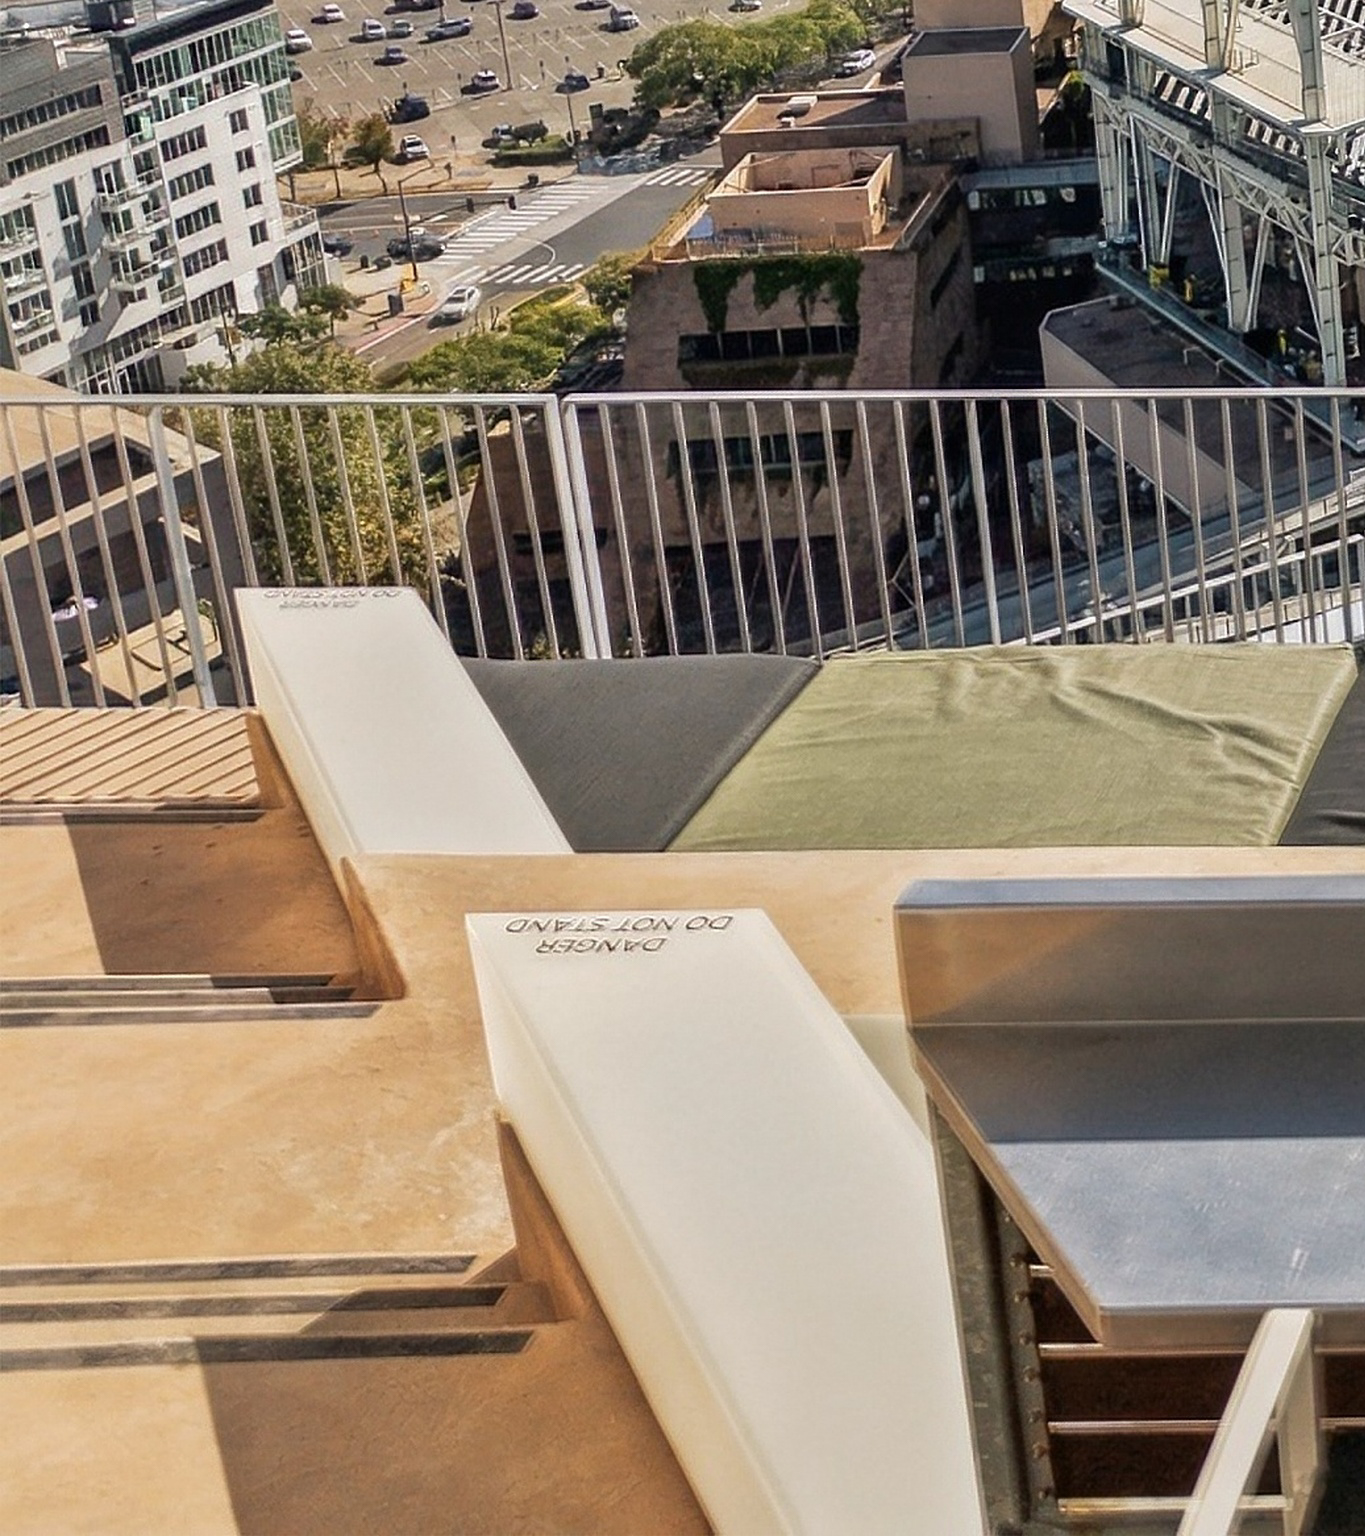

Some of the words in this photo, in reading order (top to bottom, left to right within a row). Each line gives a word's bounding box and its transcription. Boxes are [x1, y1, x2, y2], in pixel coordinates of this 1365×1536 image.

[505, 916, 608, 933] STAND
[612, 916, 679, 932] NOT
[685, 915, 734, 931] DO
[535, 937, 667, 954] DANGER
